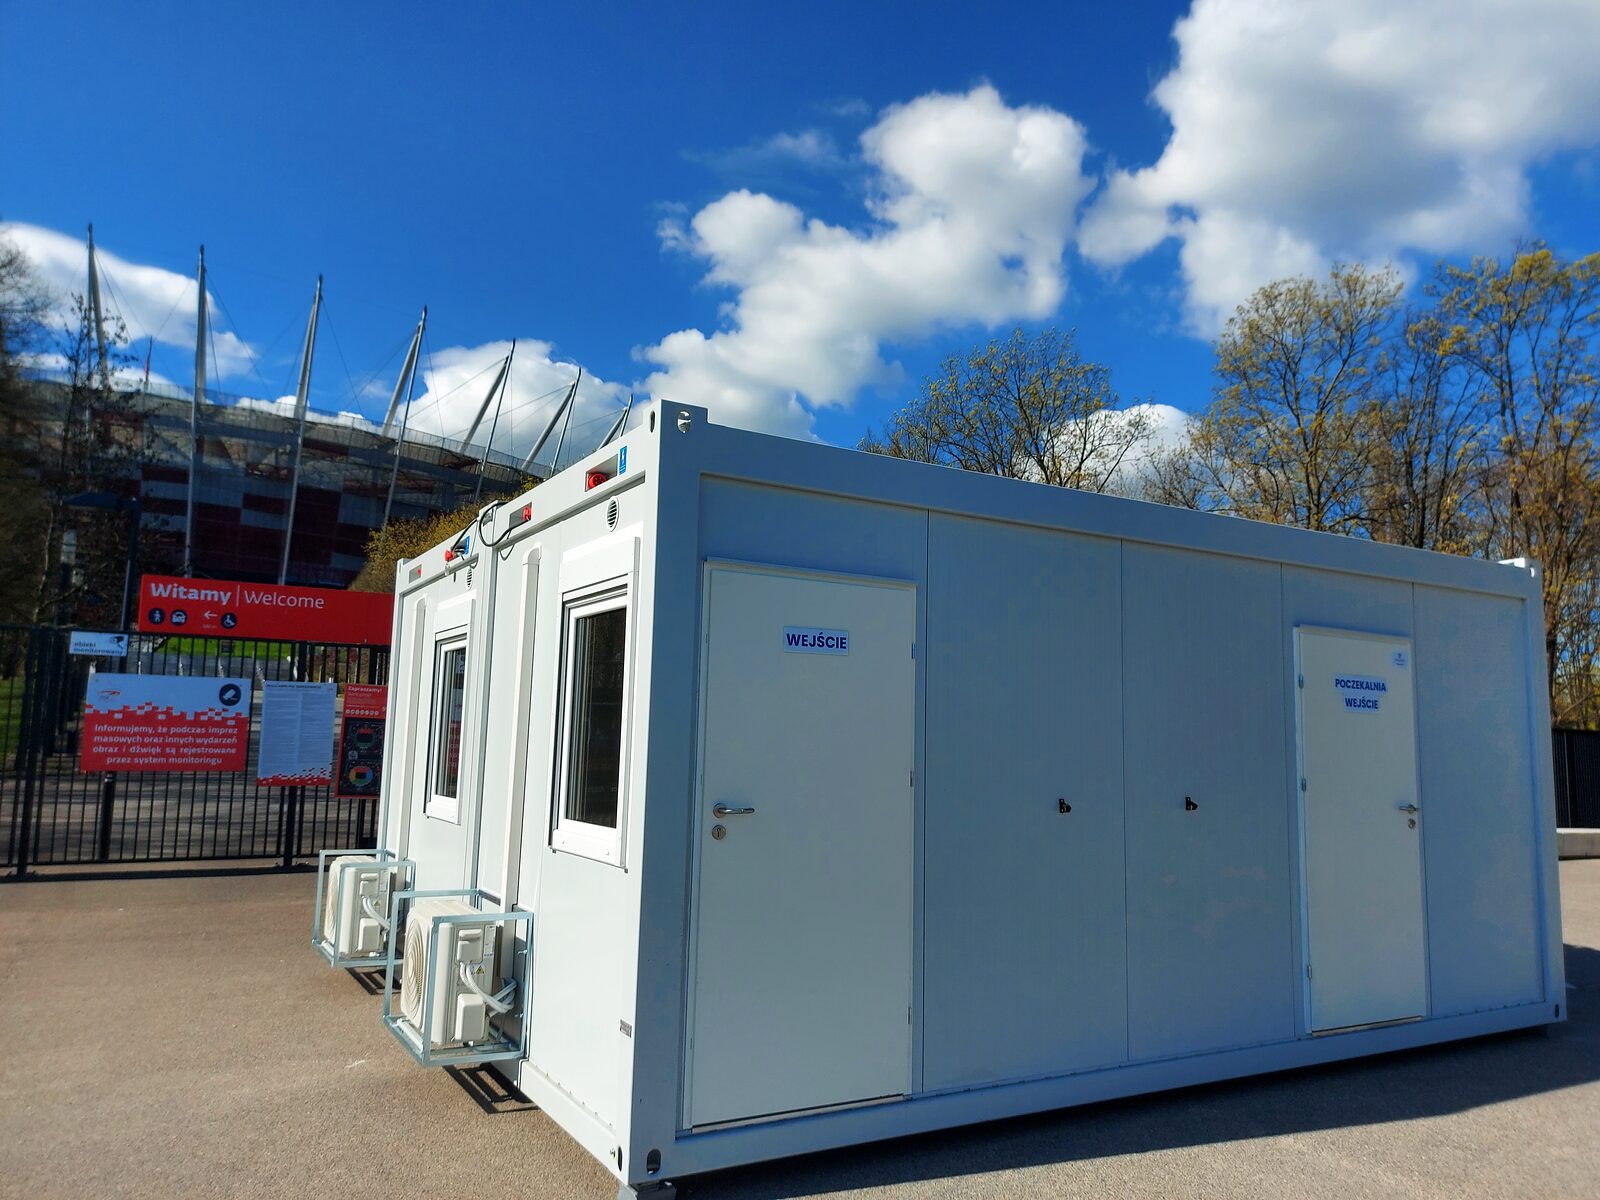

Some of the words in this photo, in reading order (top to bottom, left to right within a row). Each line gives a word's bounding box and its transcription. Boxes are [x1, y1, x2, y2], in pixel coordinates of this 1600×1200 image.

[151, 583, 232, 605] Witamy
[244, 590, 325, 609] Welcome
[786, 631, 847, 649] WEJŚCIE
[1335, 678, 1387, 692] POCZEKALNIA
[1344, 696, 1379, 710] WEJŚCIE
[95, 724, 155, 734] Informujemy,
[158, 724, 168, 733] że
[170, 725, 206, 734] podczas
[208, 725, 238, 735] imprez
[94, 735, 142, 744] masowych
[165, 735, 194, 744] innych
[195, 736, 238, 745] wydarzeń
[130, 746, 161, 754] dźwięk
[166, 747, 176, 755] są
[180, 746, 236, 755] rejestrowane
[106, 757, 131, 765] przez
[134, 756, 167, 765] system
[169, 756, 223, 765] monitoringu
